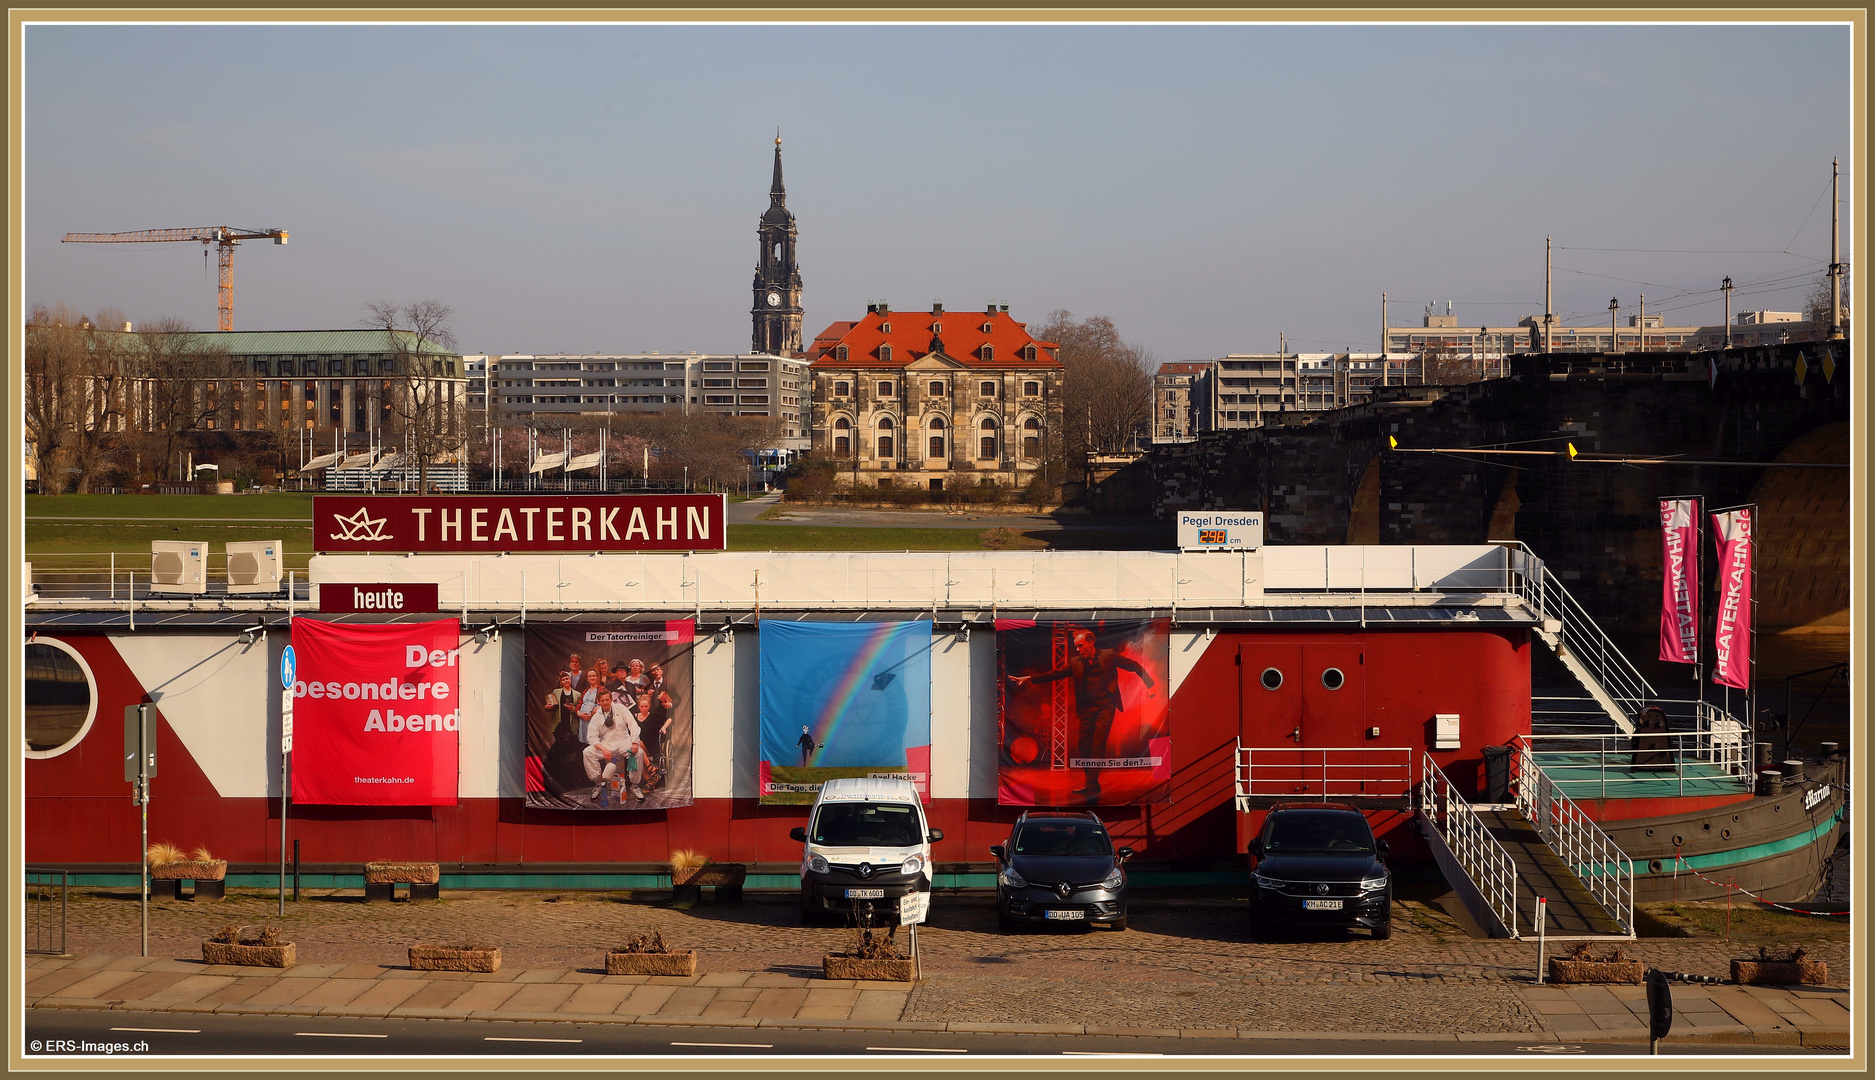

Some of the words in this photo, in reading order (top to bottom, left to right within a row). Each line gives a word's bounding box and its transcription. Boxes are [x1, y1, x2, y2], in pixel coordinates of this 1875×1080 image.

[411, 506, 710, 542] THEATERKAHN
[1182, 516, 1212, 528] Pegel
[1215, 516, 1259, 526] Dresden
[1199, 530, 1226, 543] 298
[353, 587, 404, 609] heute
[590, 633, 605, 641] Der
[606, 632, 663, 641] Tatortreiniger
[405, 645, 459, 668] Der
[293, 674, 450, 700] besondere
[363, 708, 459, 732] Abend
[1075, 759, 1107, 767] Kennen
[1108, 759, 1121, 767] Sie
[1122, 758, 1151, 767] den?...
[354, 776, 415, 784] theaterkahn.de
[770, 783, 784, 791] Die
[785, 783, 807, 793] Tage,
